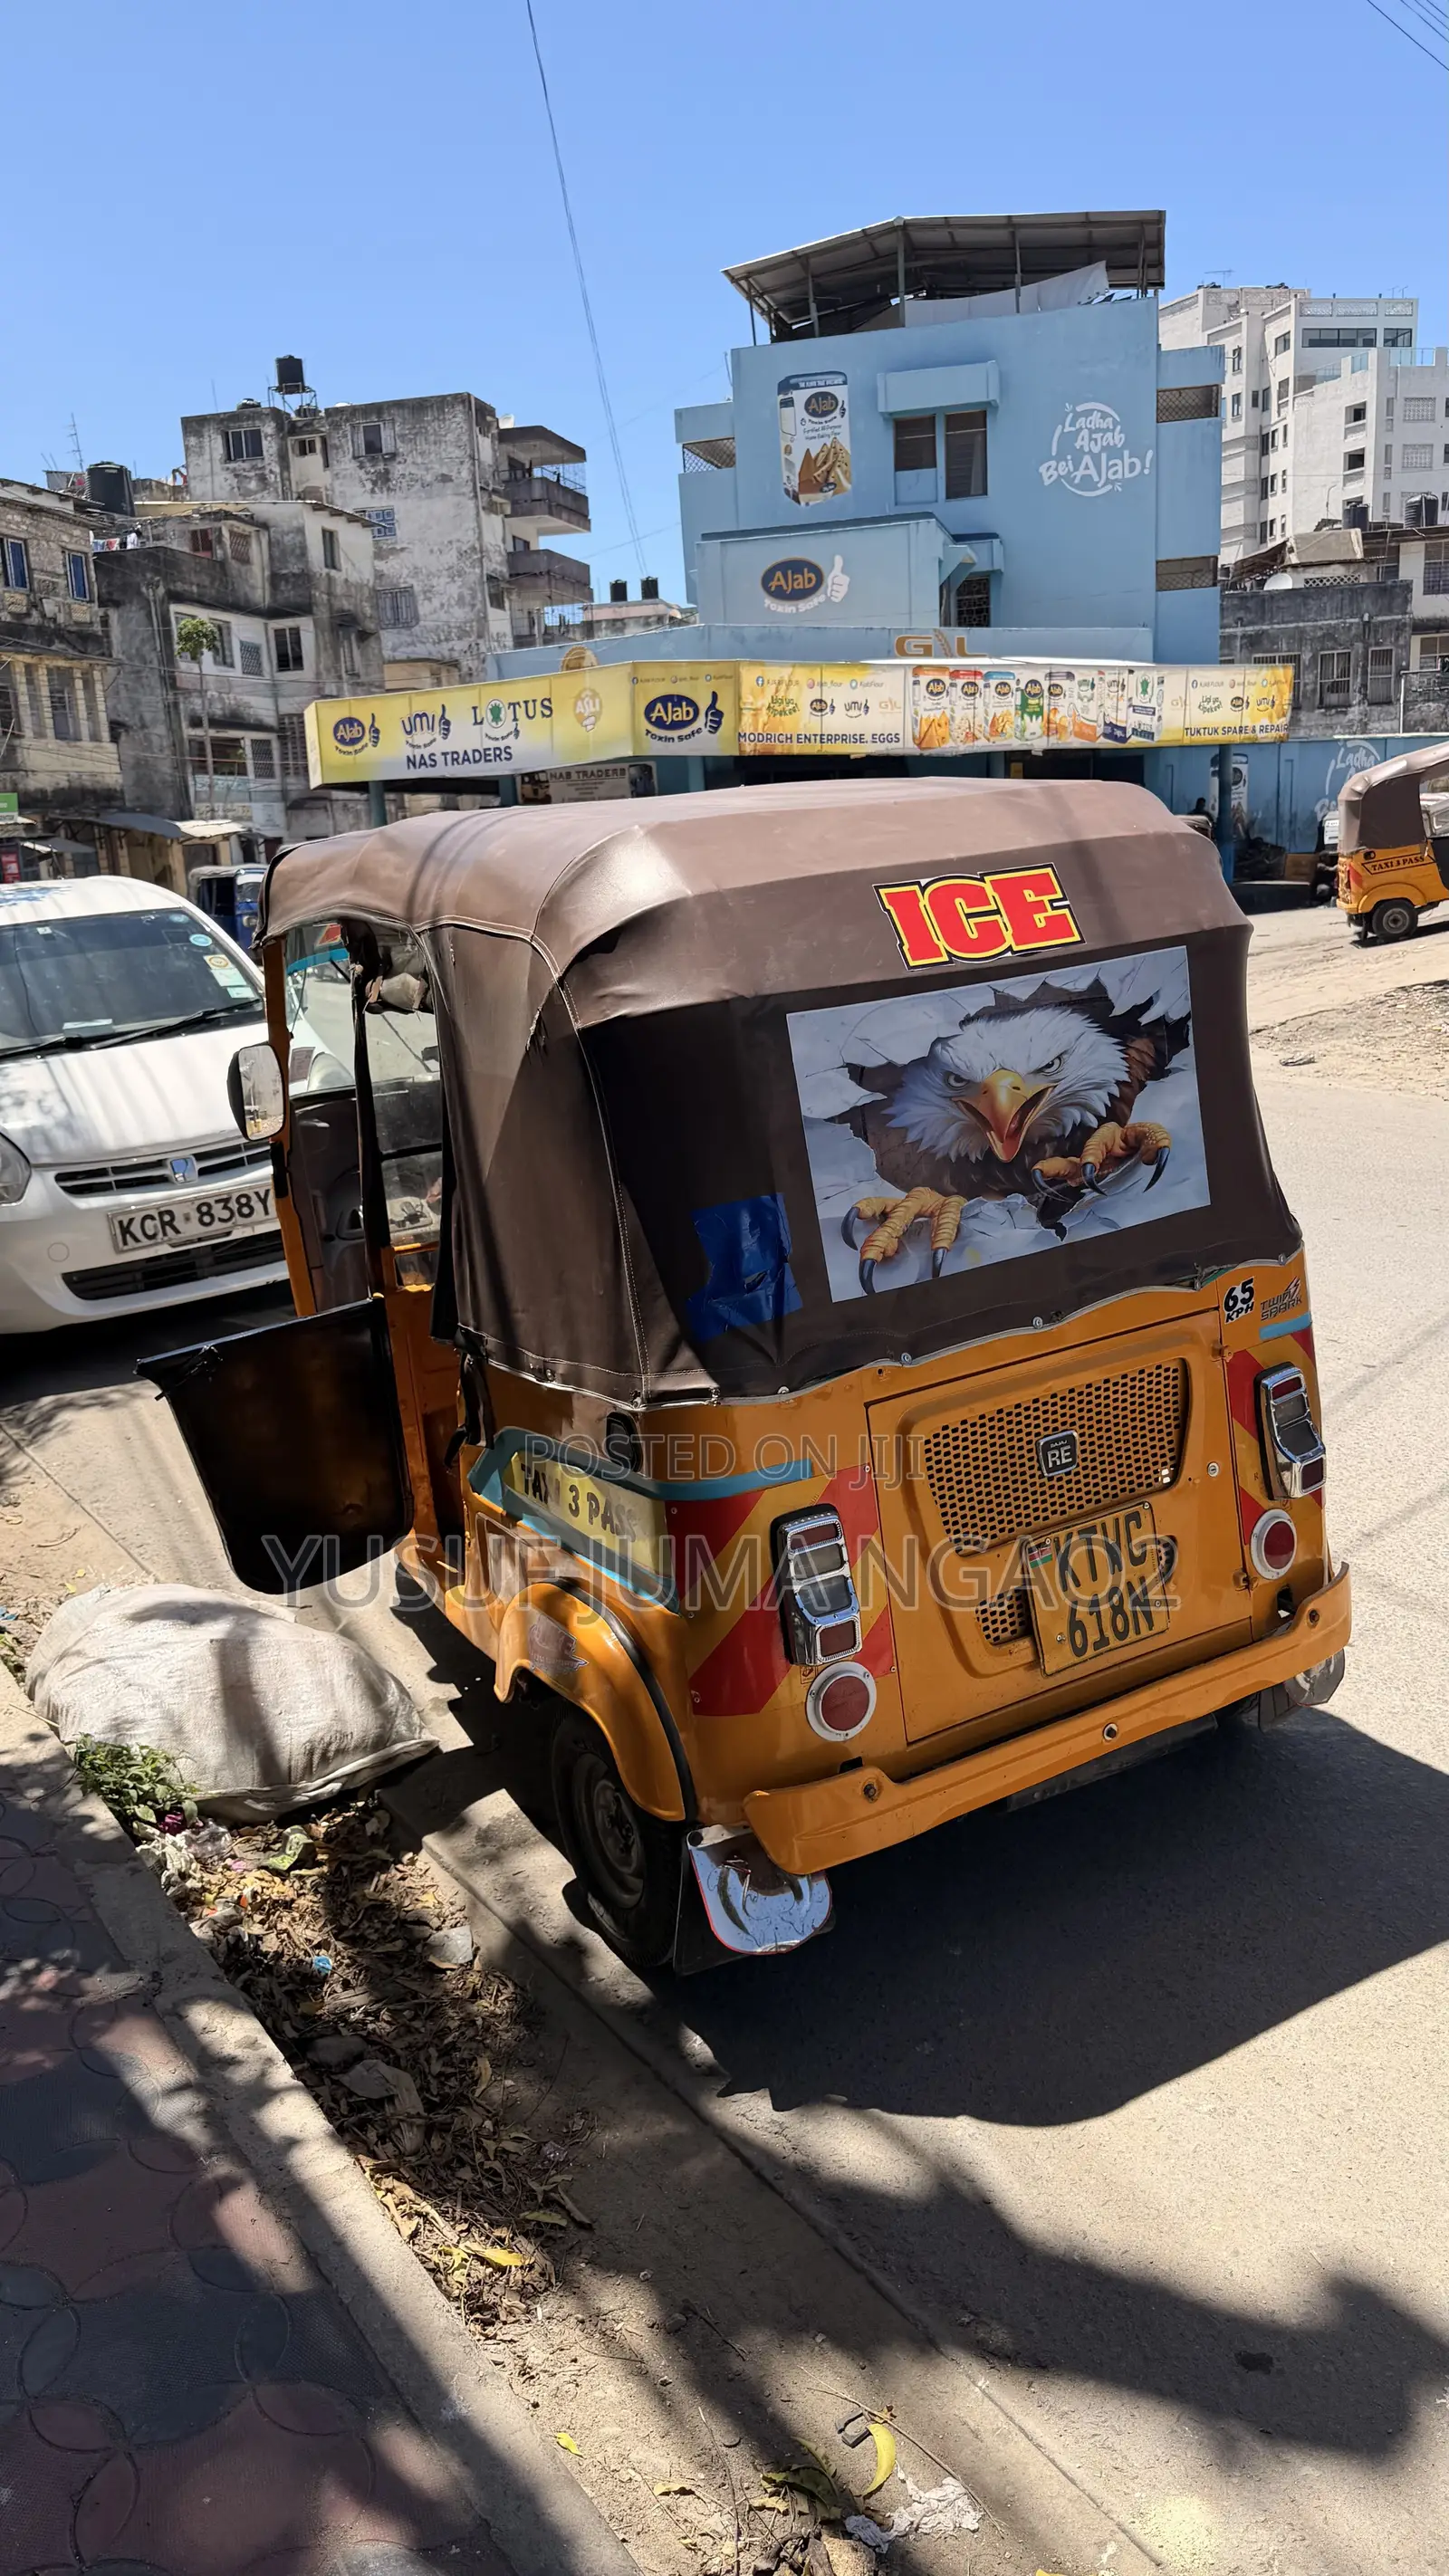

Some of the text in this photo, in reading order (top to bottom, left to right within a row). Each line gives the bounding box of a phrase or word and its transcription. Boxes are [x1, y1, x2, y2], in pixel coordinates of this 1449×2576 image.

[1064, 410, 1114, 432] Ladha
[1039, 455, 1074, 486] Bei
[764, 594, 826, 613] Toxin Safe
[575, 696, 600, 716] ASLI
[645, 727, 703, 742] Toxin Safe
[738, 732, 793, 744] MODRICH
[871, 733, 901, 744] EGGS
[1185, 724, 1290, 737] TUKTUK SPARE & REPAIR
[406, 745, 513, 770] NAS TRADERS
[1336, 746, 1375, 769] Ladha
[1371, 860, 1394, 871] TAXI
[1403, 856, 1425, 865] PASS
[874, 864, 1084, 969] ICE
[118, 1188, 271, 1247] KCR 838Y
[1223, 1277, 1255, 1312] 65
[1260, 1289, 1291, 1311] TWIN
[1225, 1301, 1254, 1324] KPH
[1260, 1297, 1302, 1322] SPARK
[1047, 1444, 1073, 1469] RE
[568, 1484, 581, 1518] 3
[1069, 1575, 1155, 1658] 618N
